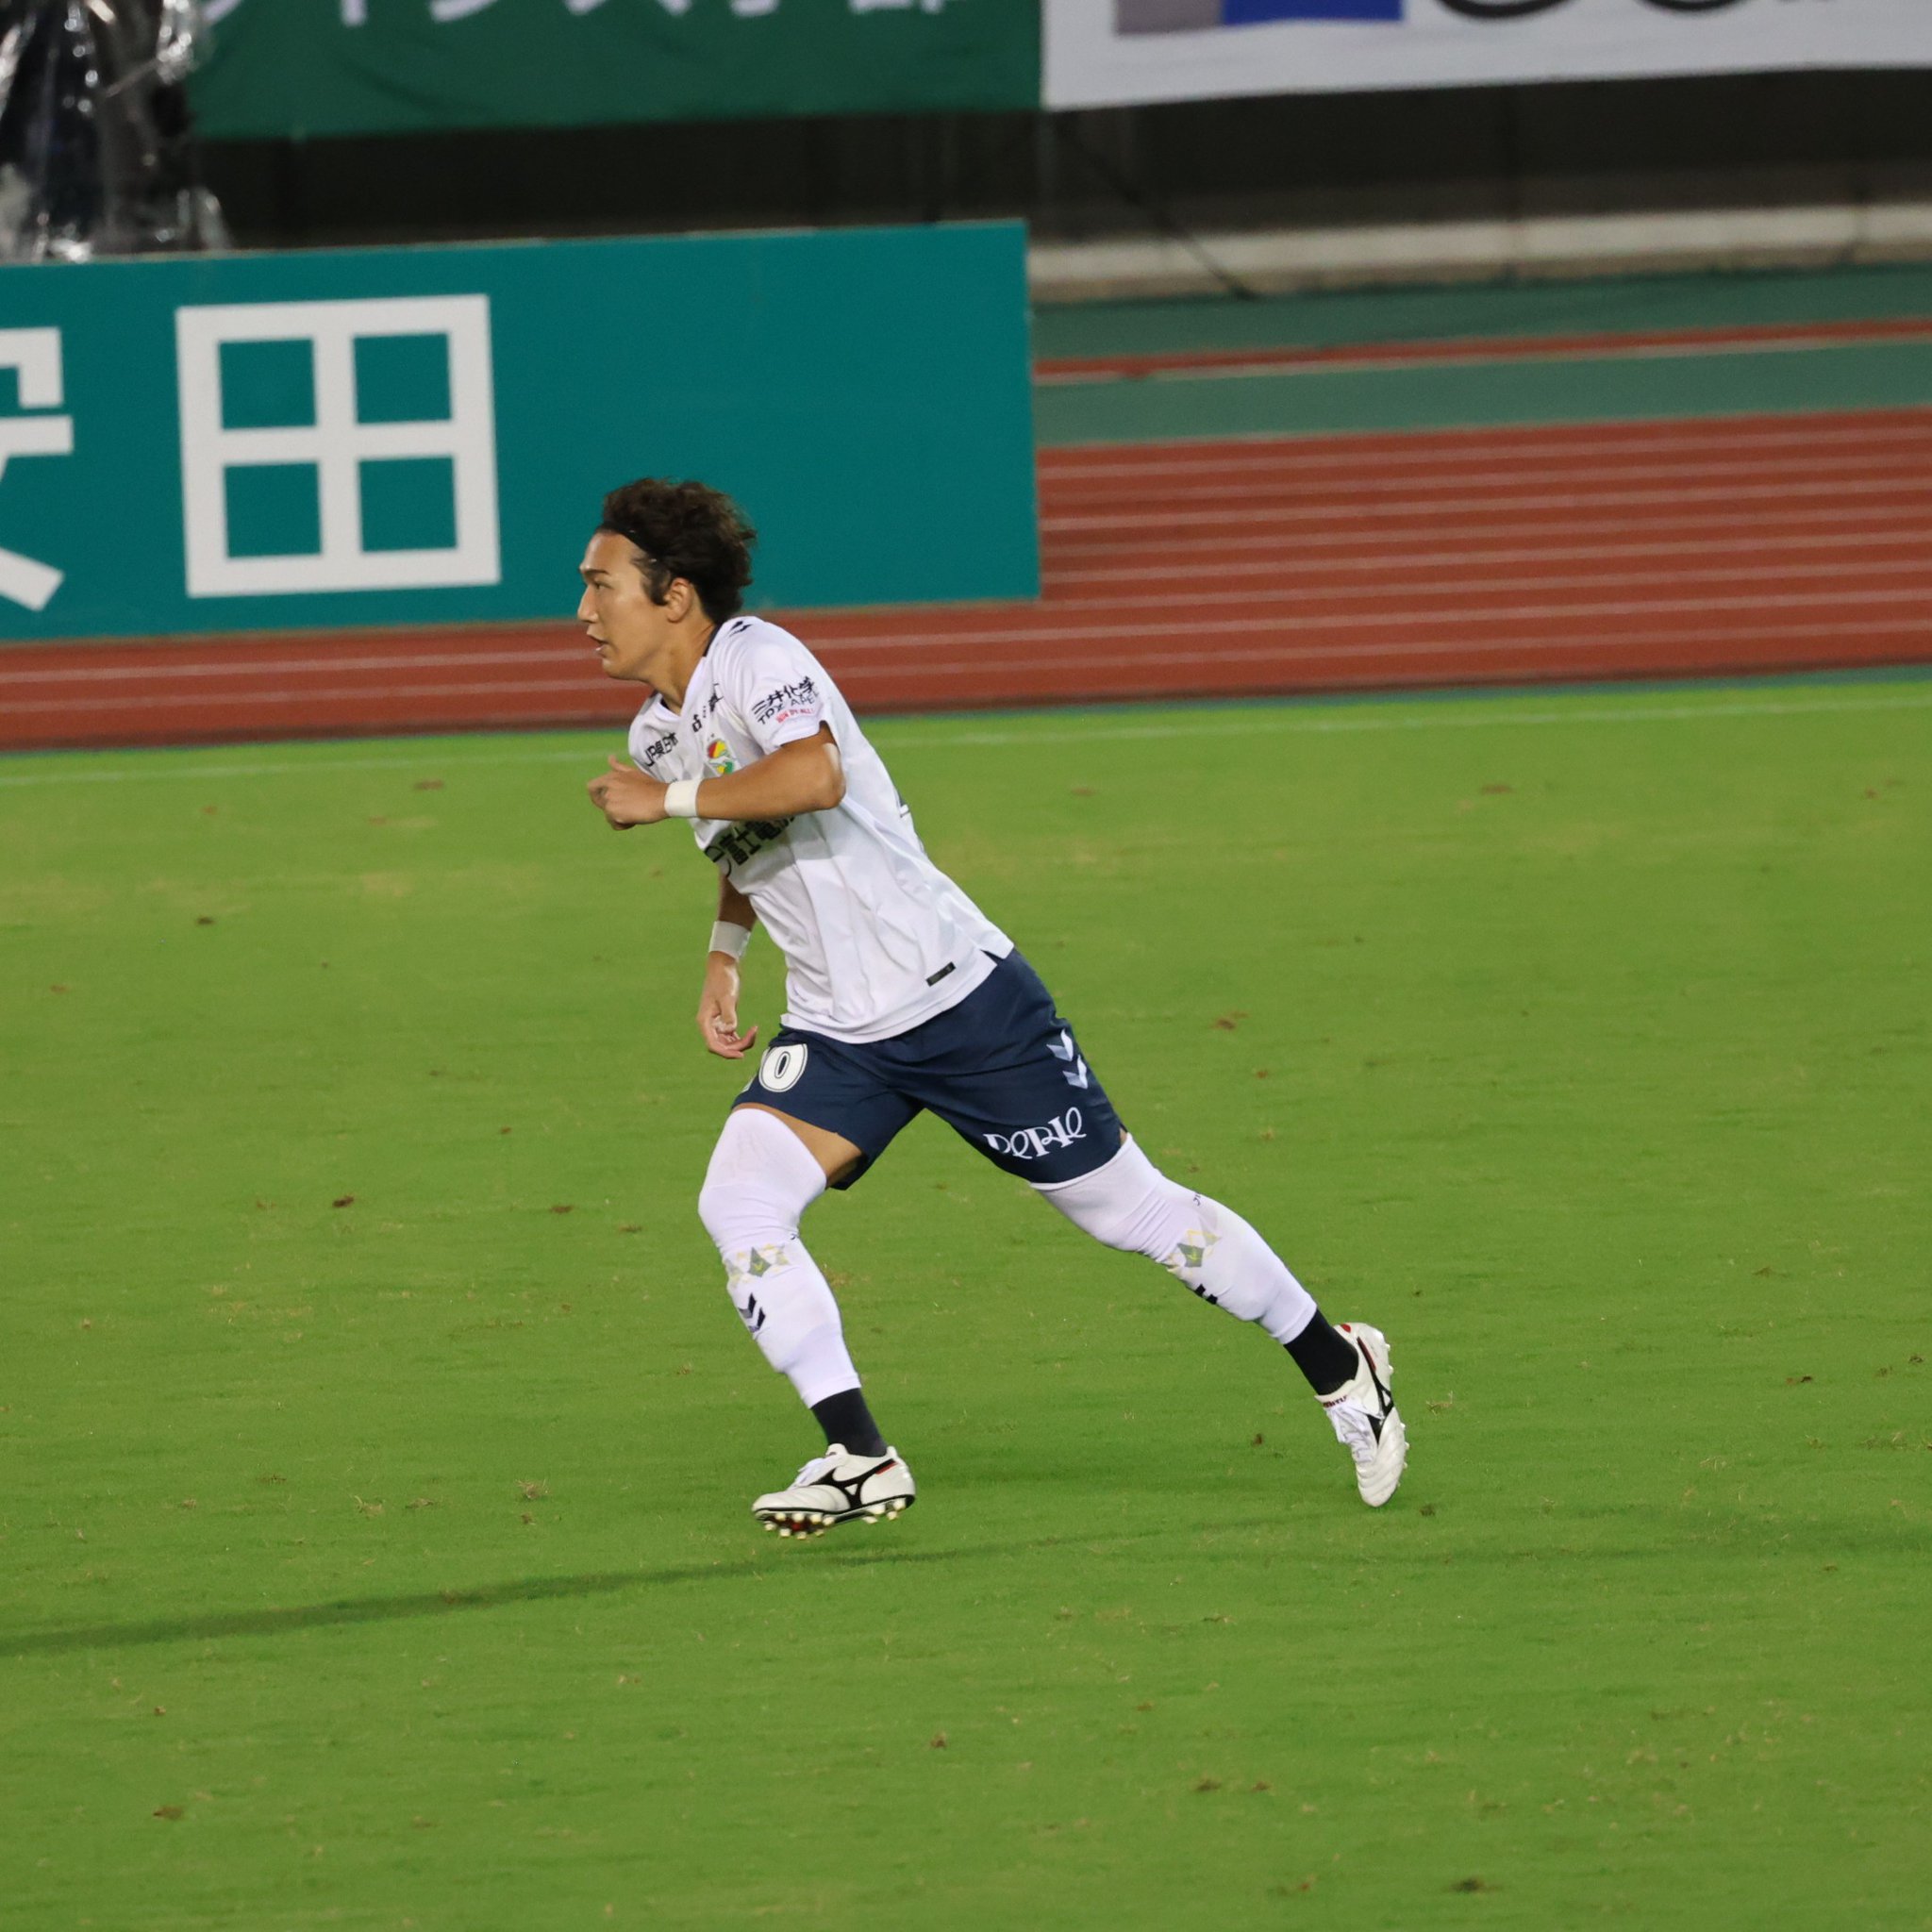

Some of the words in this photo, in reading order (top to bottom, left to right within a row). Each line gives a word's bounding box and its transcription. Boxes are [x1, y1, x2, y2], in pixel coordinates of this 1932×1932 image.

[0, 294, 501, 611] 田
[751, 675, 815, 719] 三井化学
[740, 1043, 808, 1092] 0
